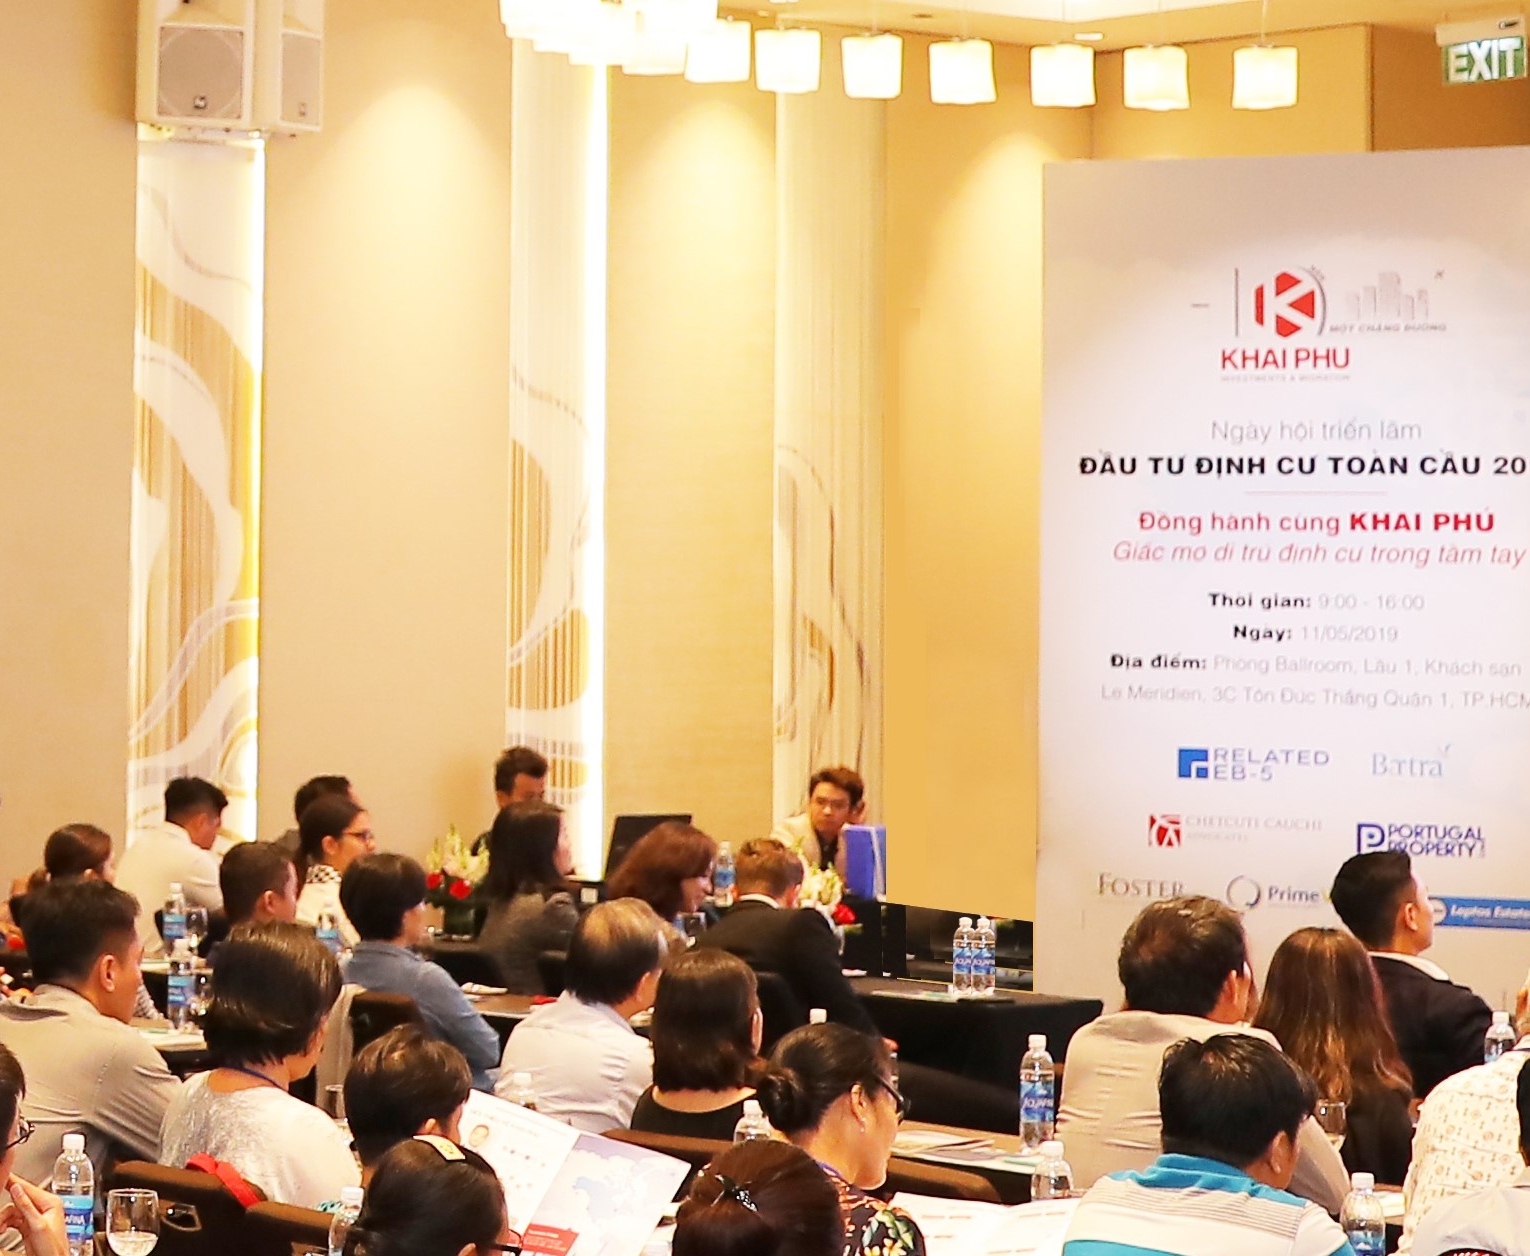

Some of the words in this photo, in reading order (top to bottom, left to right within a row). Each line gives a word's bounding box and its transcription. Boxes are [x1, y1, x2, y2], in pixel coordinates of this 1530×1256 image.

[1448, 37, 1522, 82] EXIT
[1221, 348, 1287, 370] KHAI
[1149, 454, 1187, 475] TƯ
[1196, 456, 1266, 480] ĐỊNH
[1350, 513, 1421, 532] KHAI
[1370, 545, 1430, 568] trong
[1490, 545, 1527, 570] tay
[1261, 593, 1311, 610] gian:
[1302, 625, 1399, 643] 11/05/2019
[1212, 686, 1239, 703] 3C
[1213, 749, 1330, 766] RELATED
[1213, 764, 1273, 781] EB-5
[1388, 823, 1484, 841] PORTUGAL
[1388, 839, 1477, 858] PROPERTY
[1098, 871, 1185, 898] FOSTER
[1268, 884, 1321, 904] Prime
